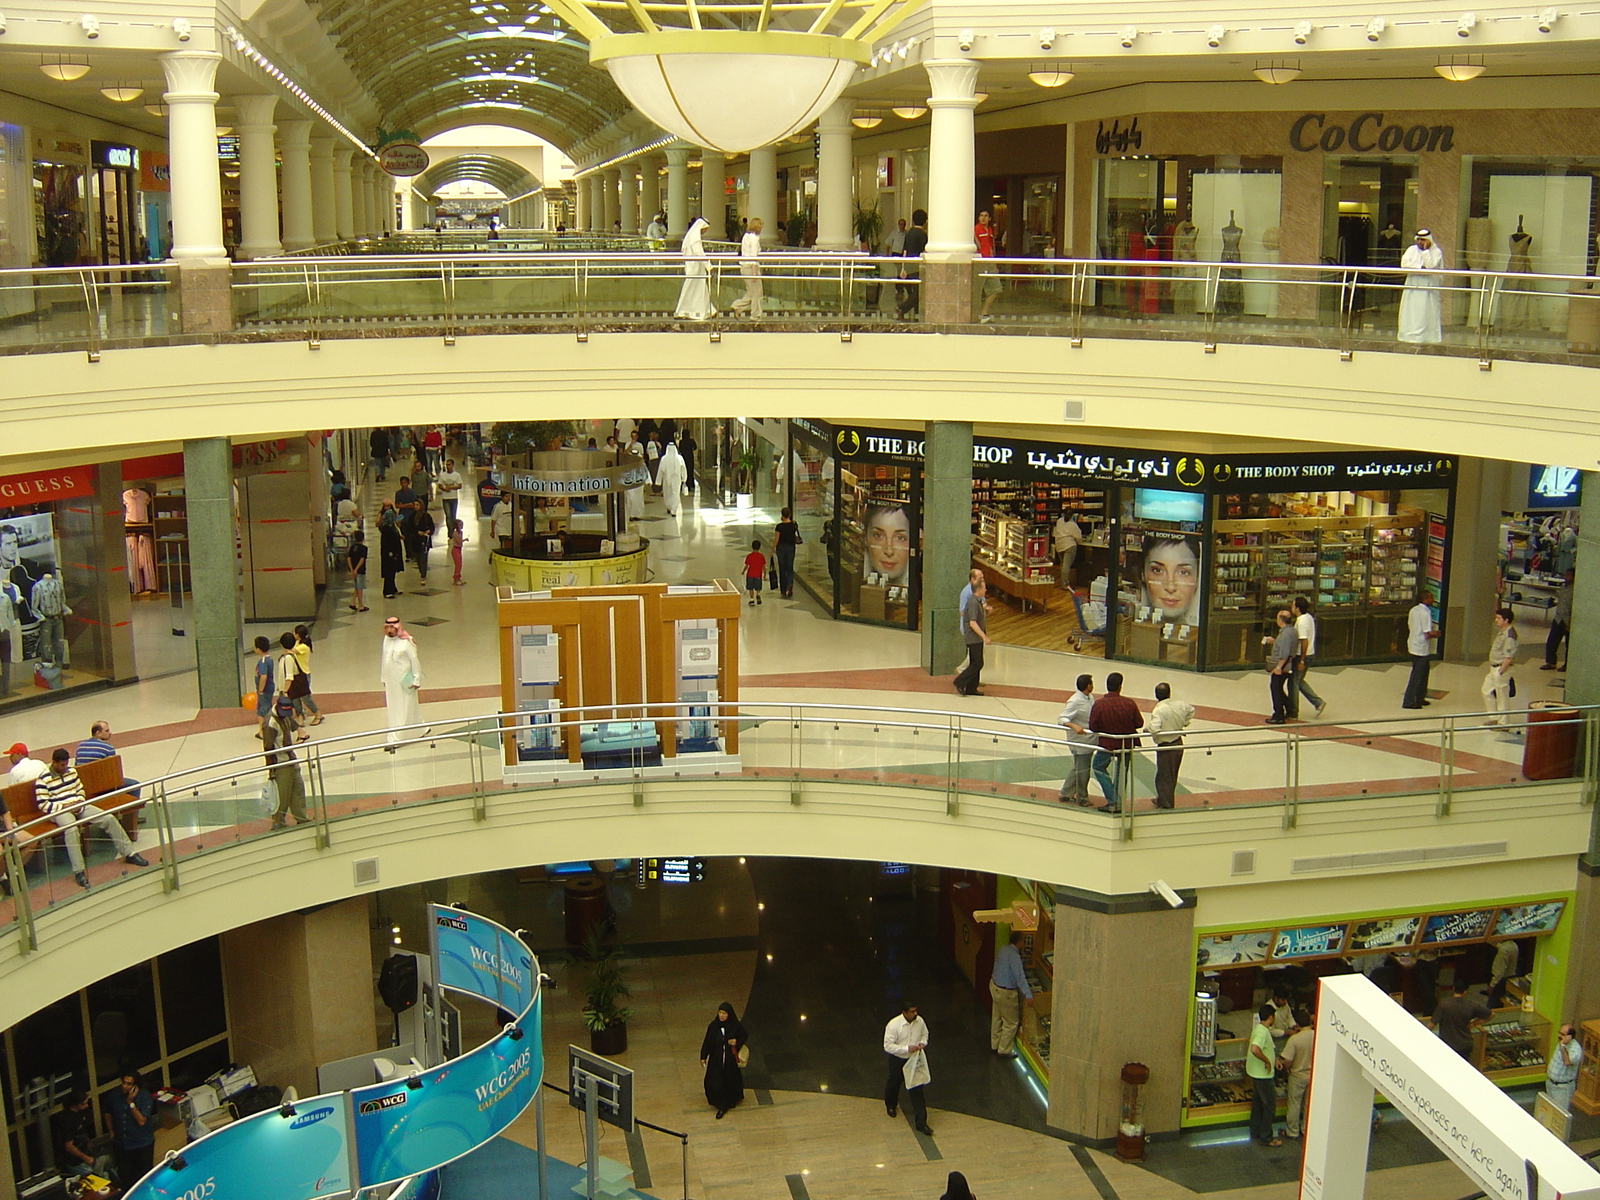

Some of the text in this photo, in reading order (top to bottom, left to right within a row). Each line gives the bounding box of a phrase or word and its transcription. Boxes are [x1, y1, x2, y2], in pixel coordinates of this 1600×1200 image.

[1289, 113, 1455, 152] CoCoon
[866, 436, 903, 454] THE
[972, 445, 1013, 465] HOP
[1235, 465, 1335, 479] THE BODY SHOP
[1, 475, 75, 498] GUESS
[512, 475, 610, 493] Information
[1172, 532, 1186, 540] SHOP
[541, 575, 561, 585] real
[451, 920, 466, 930] WCG
[1321, 929, 1344, 942] STAMPS
[1364, 922, 1416, 949] ENGRAVING
[470, 945, 498, 969] WCG
[500, 959, 522, 984] 2005
[474, 1047, 531, 1102] WCG 2005
[382, 1094, 404, 1107] WCG
[477, 1067, 530, 1112] UAE Championship
[1330, 1010, 1349, 1038] Dear
[1351, 1032, 1376, 1068] HSBC,
[1407, 1086, 1450, 1132] expenses
[1450, 1126, 1468, 1149] are
[1470, 1141, 1494, 1173] here
[1495, 1168, 1523, 1198] again
[294, 1111, 331, 1125] SAMSUNG
[175, 1176, 216, 1200] 005
